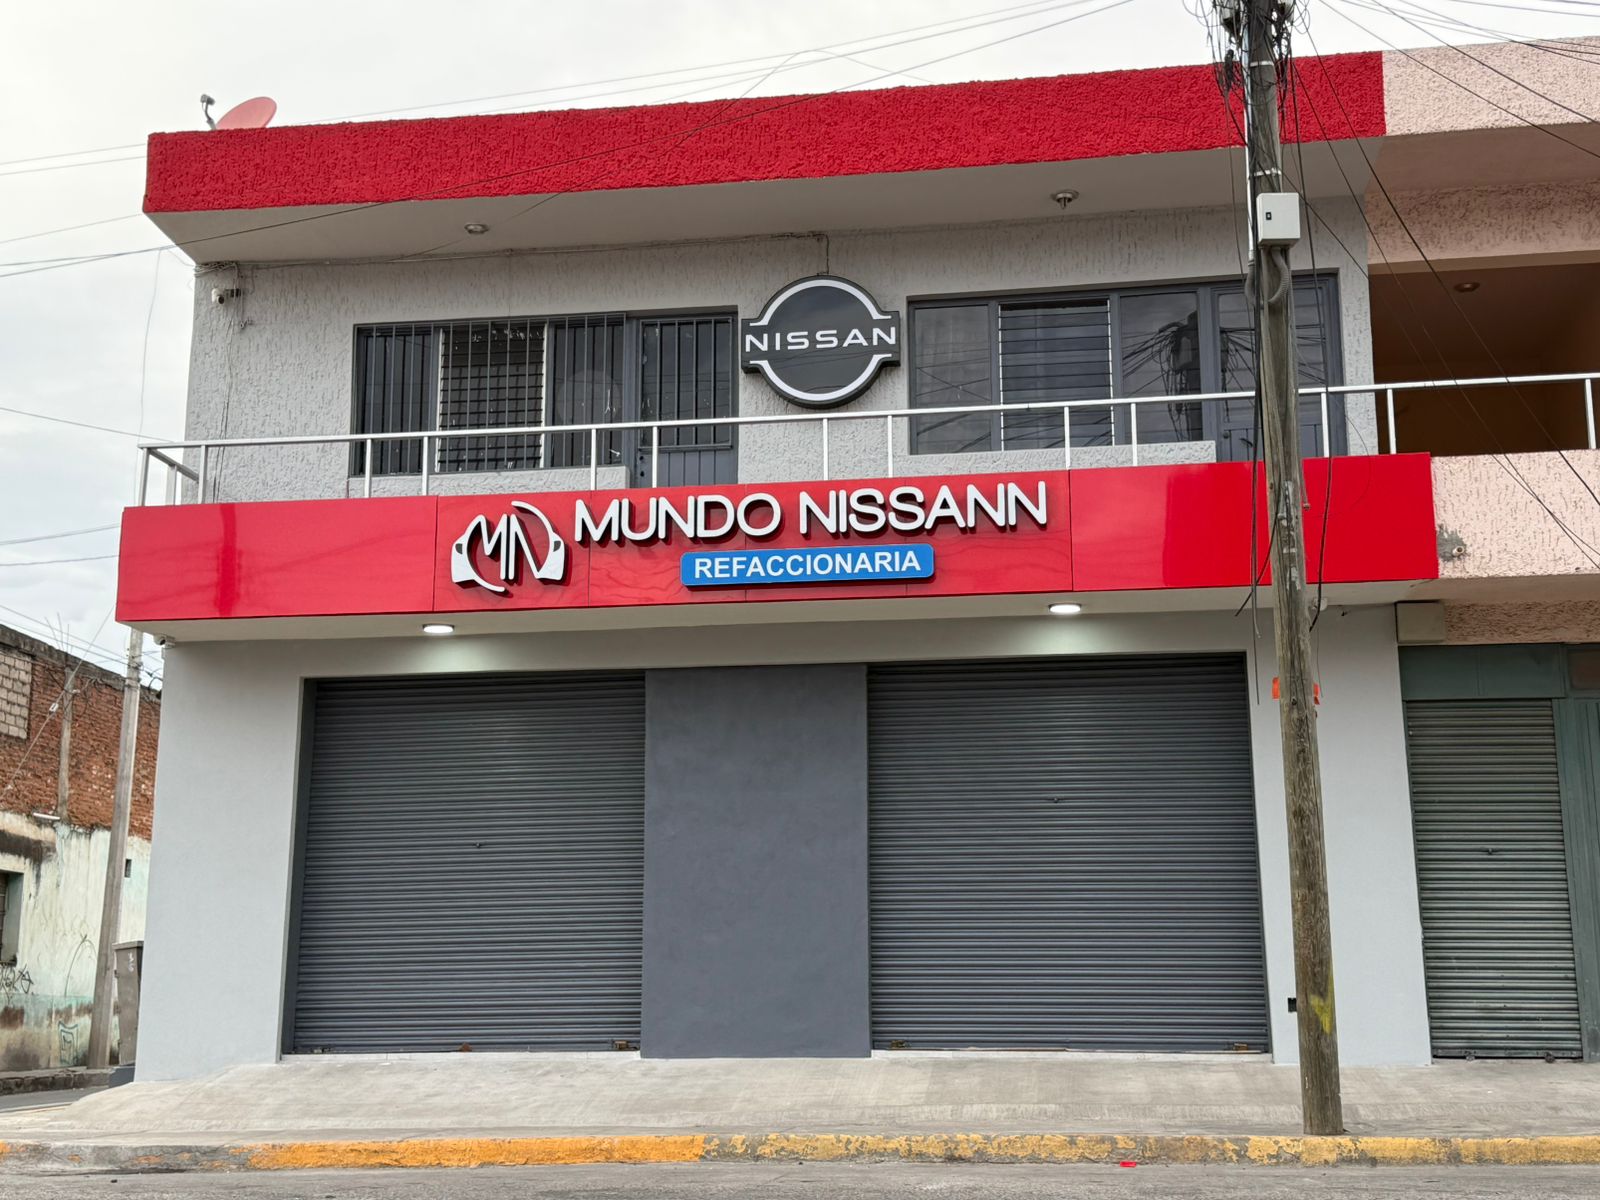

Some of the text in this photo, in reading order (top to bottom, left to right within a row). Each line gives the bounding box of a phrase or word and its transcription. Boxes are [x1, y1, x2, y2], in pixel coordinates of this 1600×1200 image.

[745, 326, 896, 352] NISSAN
[574, 480, 1048, 541] MUNDO NISSANN
[693, 550, 922, 579] REFACCIONARIA
